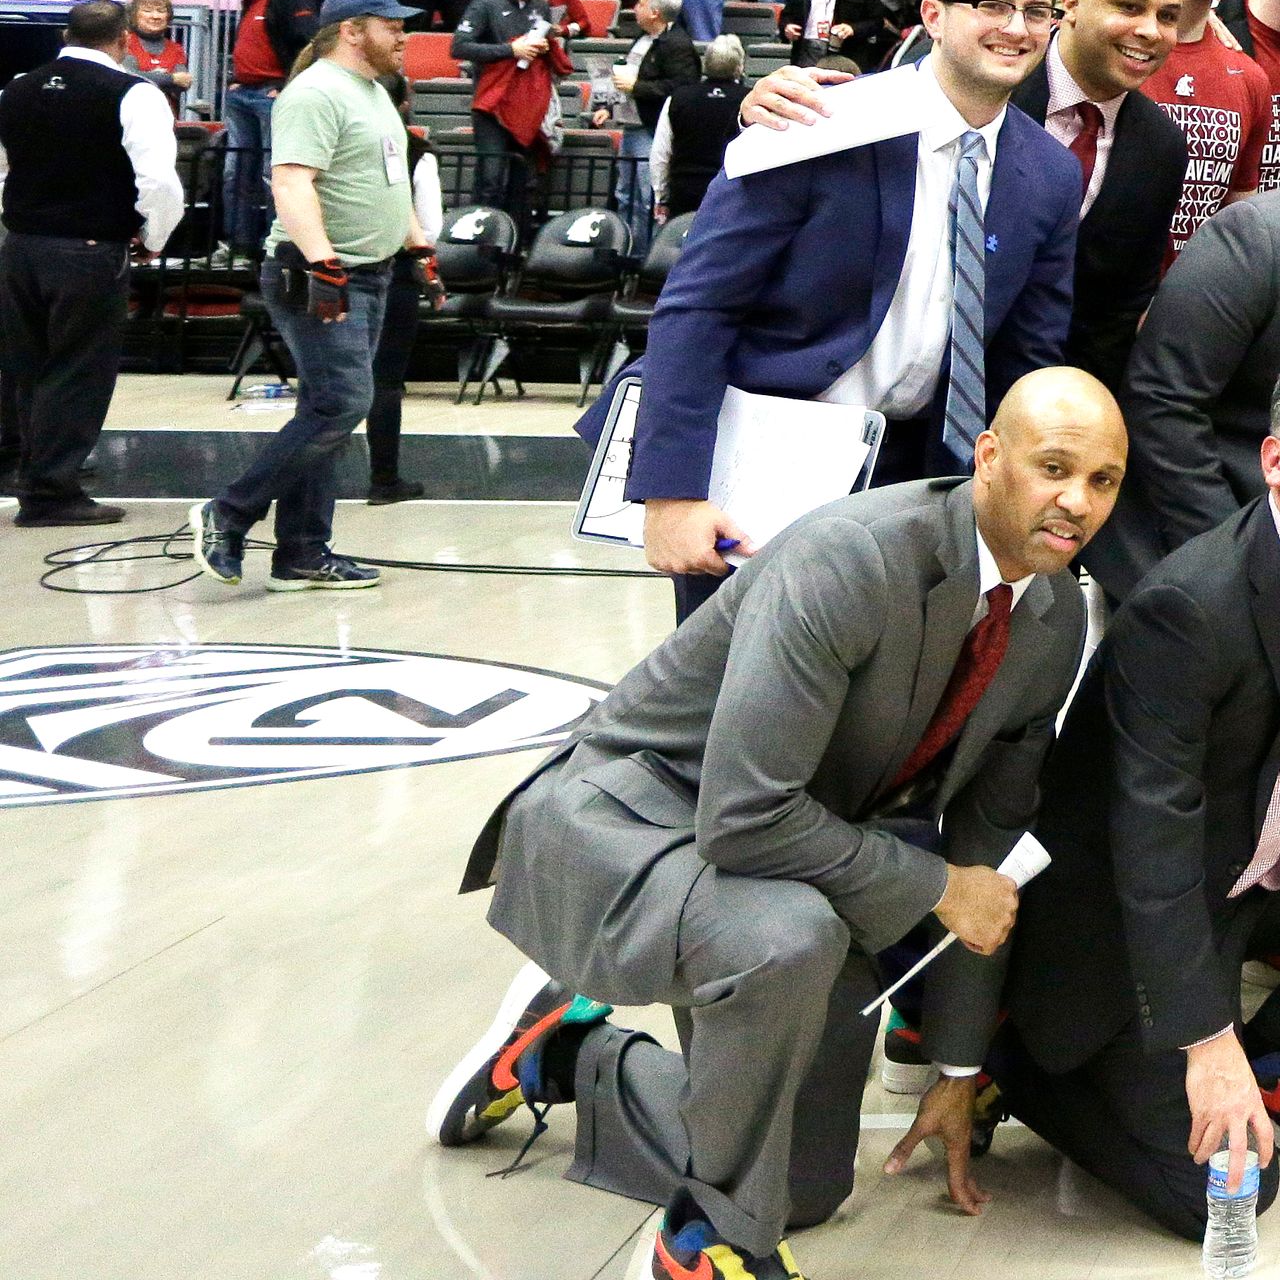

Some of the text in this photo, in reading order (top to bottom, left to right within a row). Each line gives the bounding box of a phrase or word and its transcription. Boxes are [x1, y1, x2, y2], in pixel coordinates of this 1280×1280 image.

[1200, 107, 1240, 128] YOU
[1200, 124, 1240, 144] YOU
[1201, 140, 1239, 161] YOU
